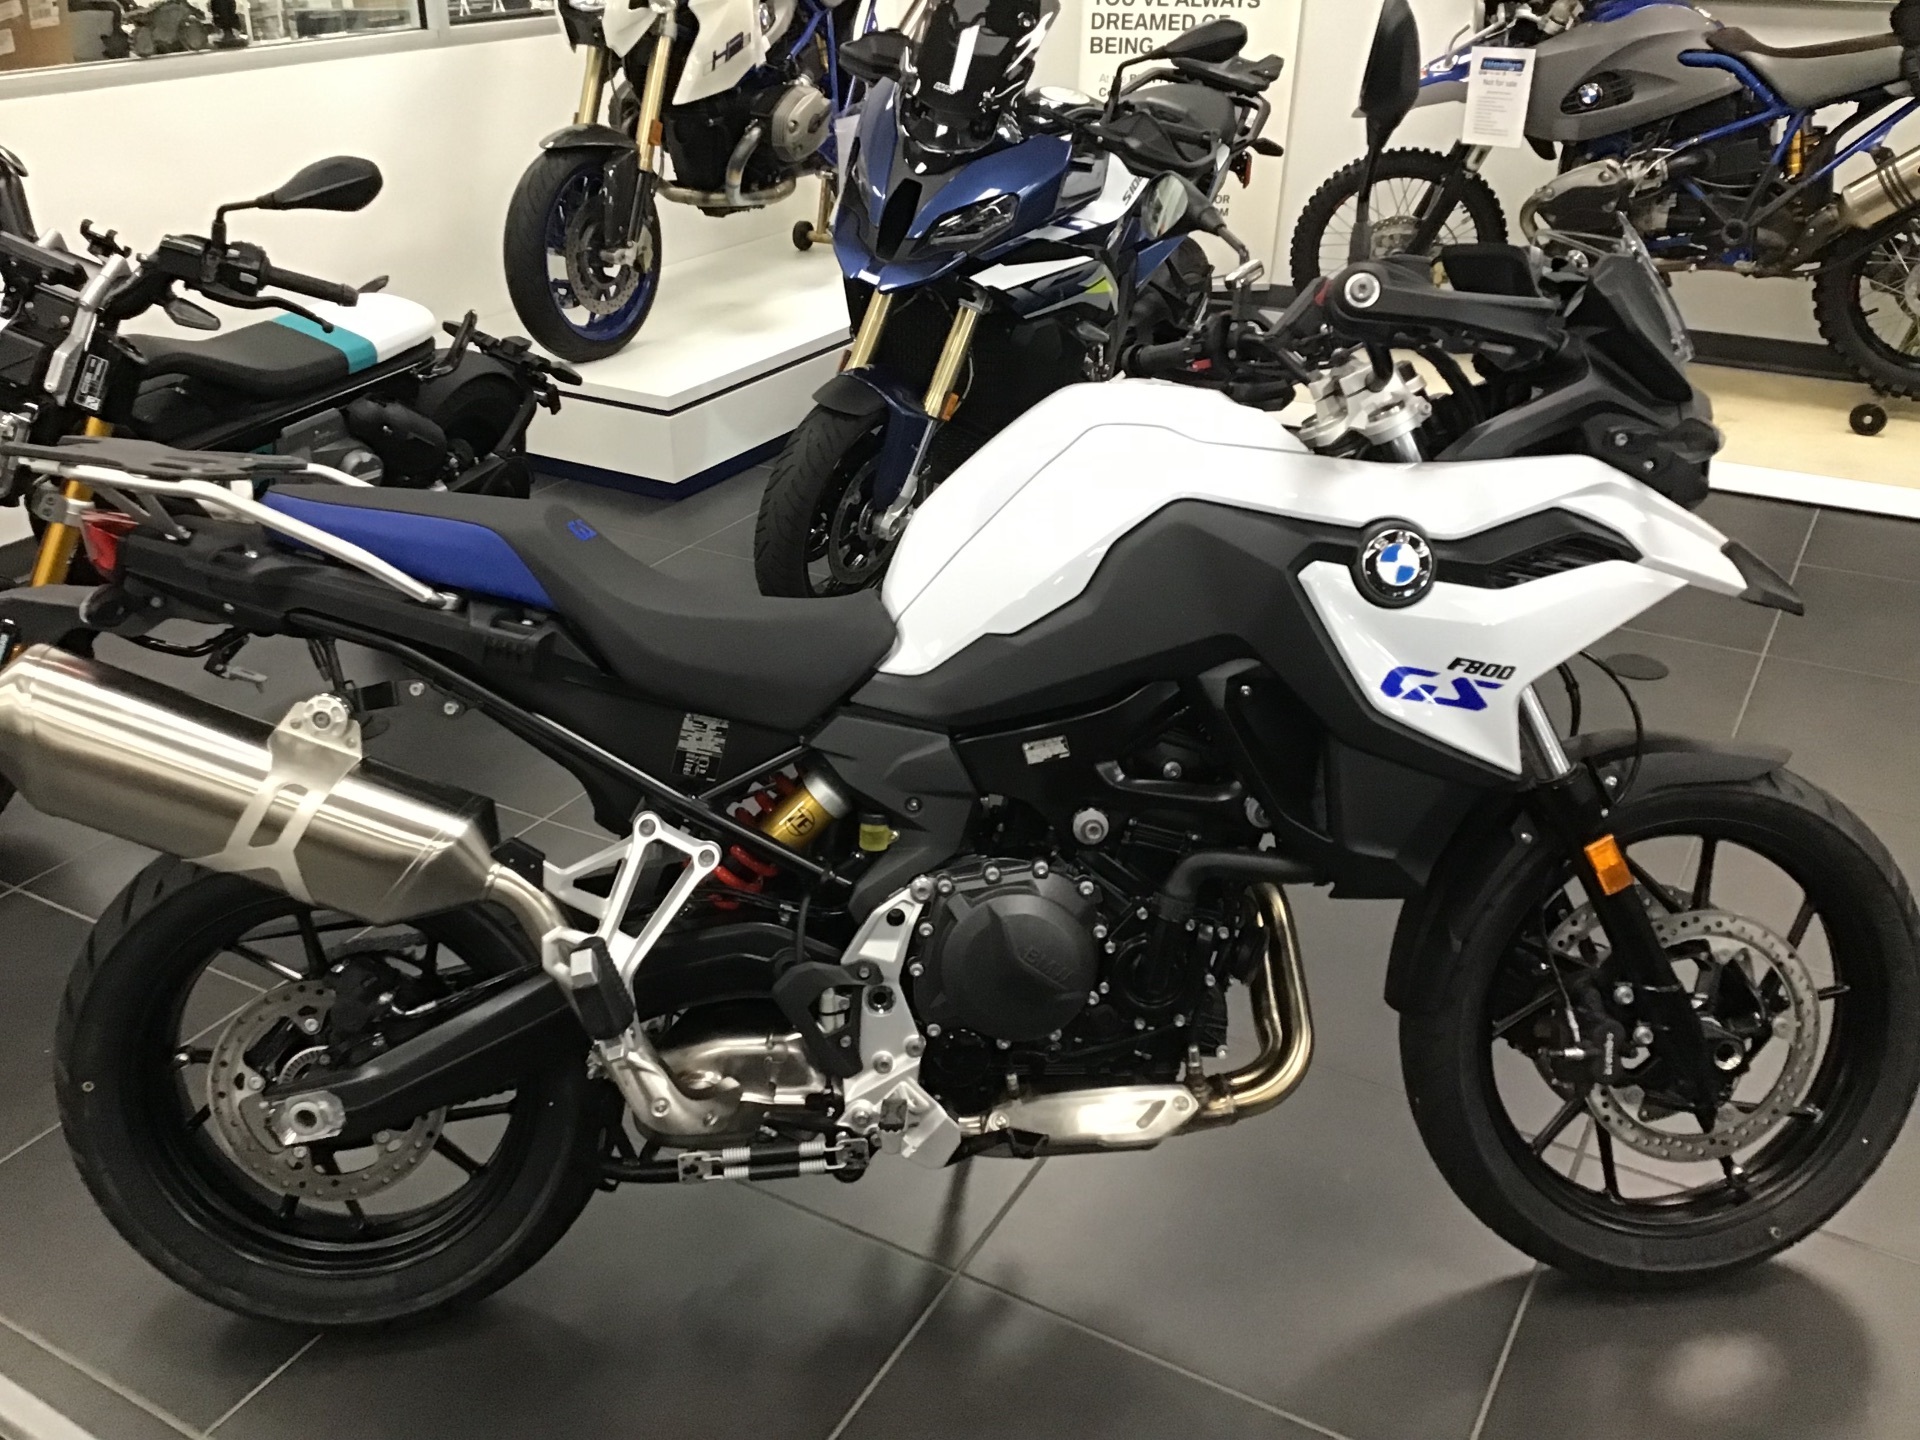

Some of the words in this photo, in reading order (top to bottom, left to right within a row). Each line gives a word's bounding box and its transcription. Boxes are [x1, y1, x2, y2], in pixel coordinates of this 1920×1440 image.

[1091, 12, 1195, 31] DREAMED
[1090, 36, 1153, 54] BEING
[1447, 657, 1517, 681] F800
[1380, 666, 1505, 711] GS
